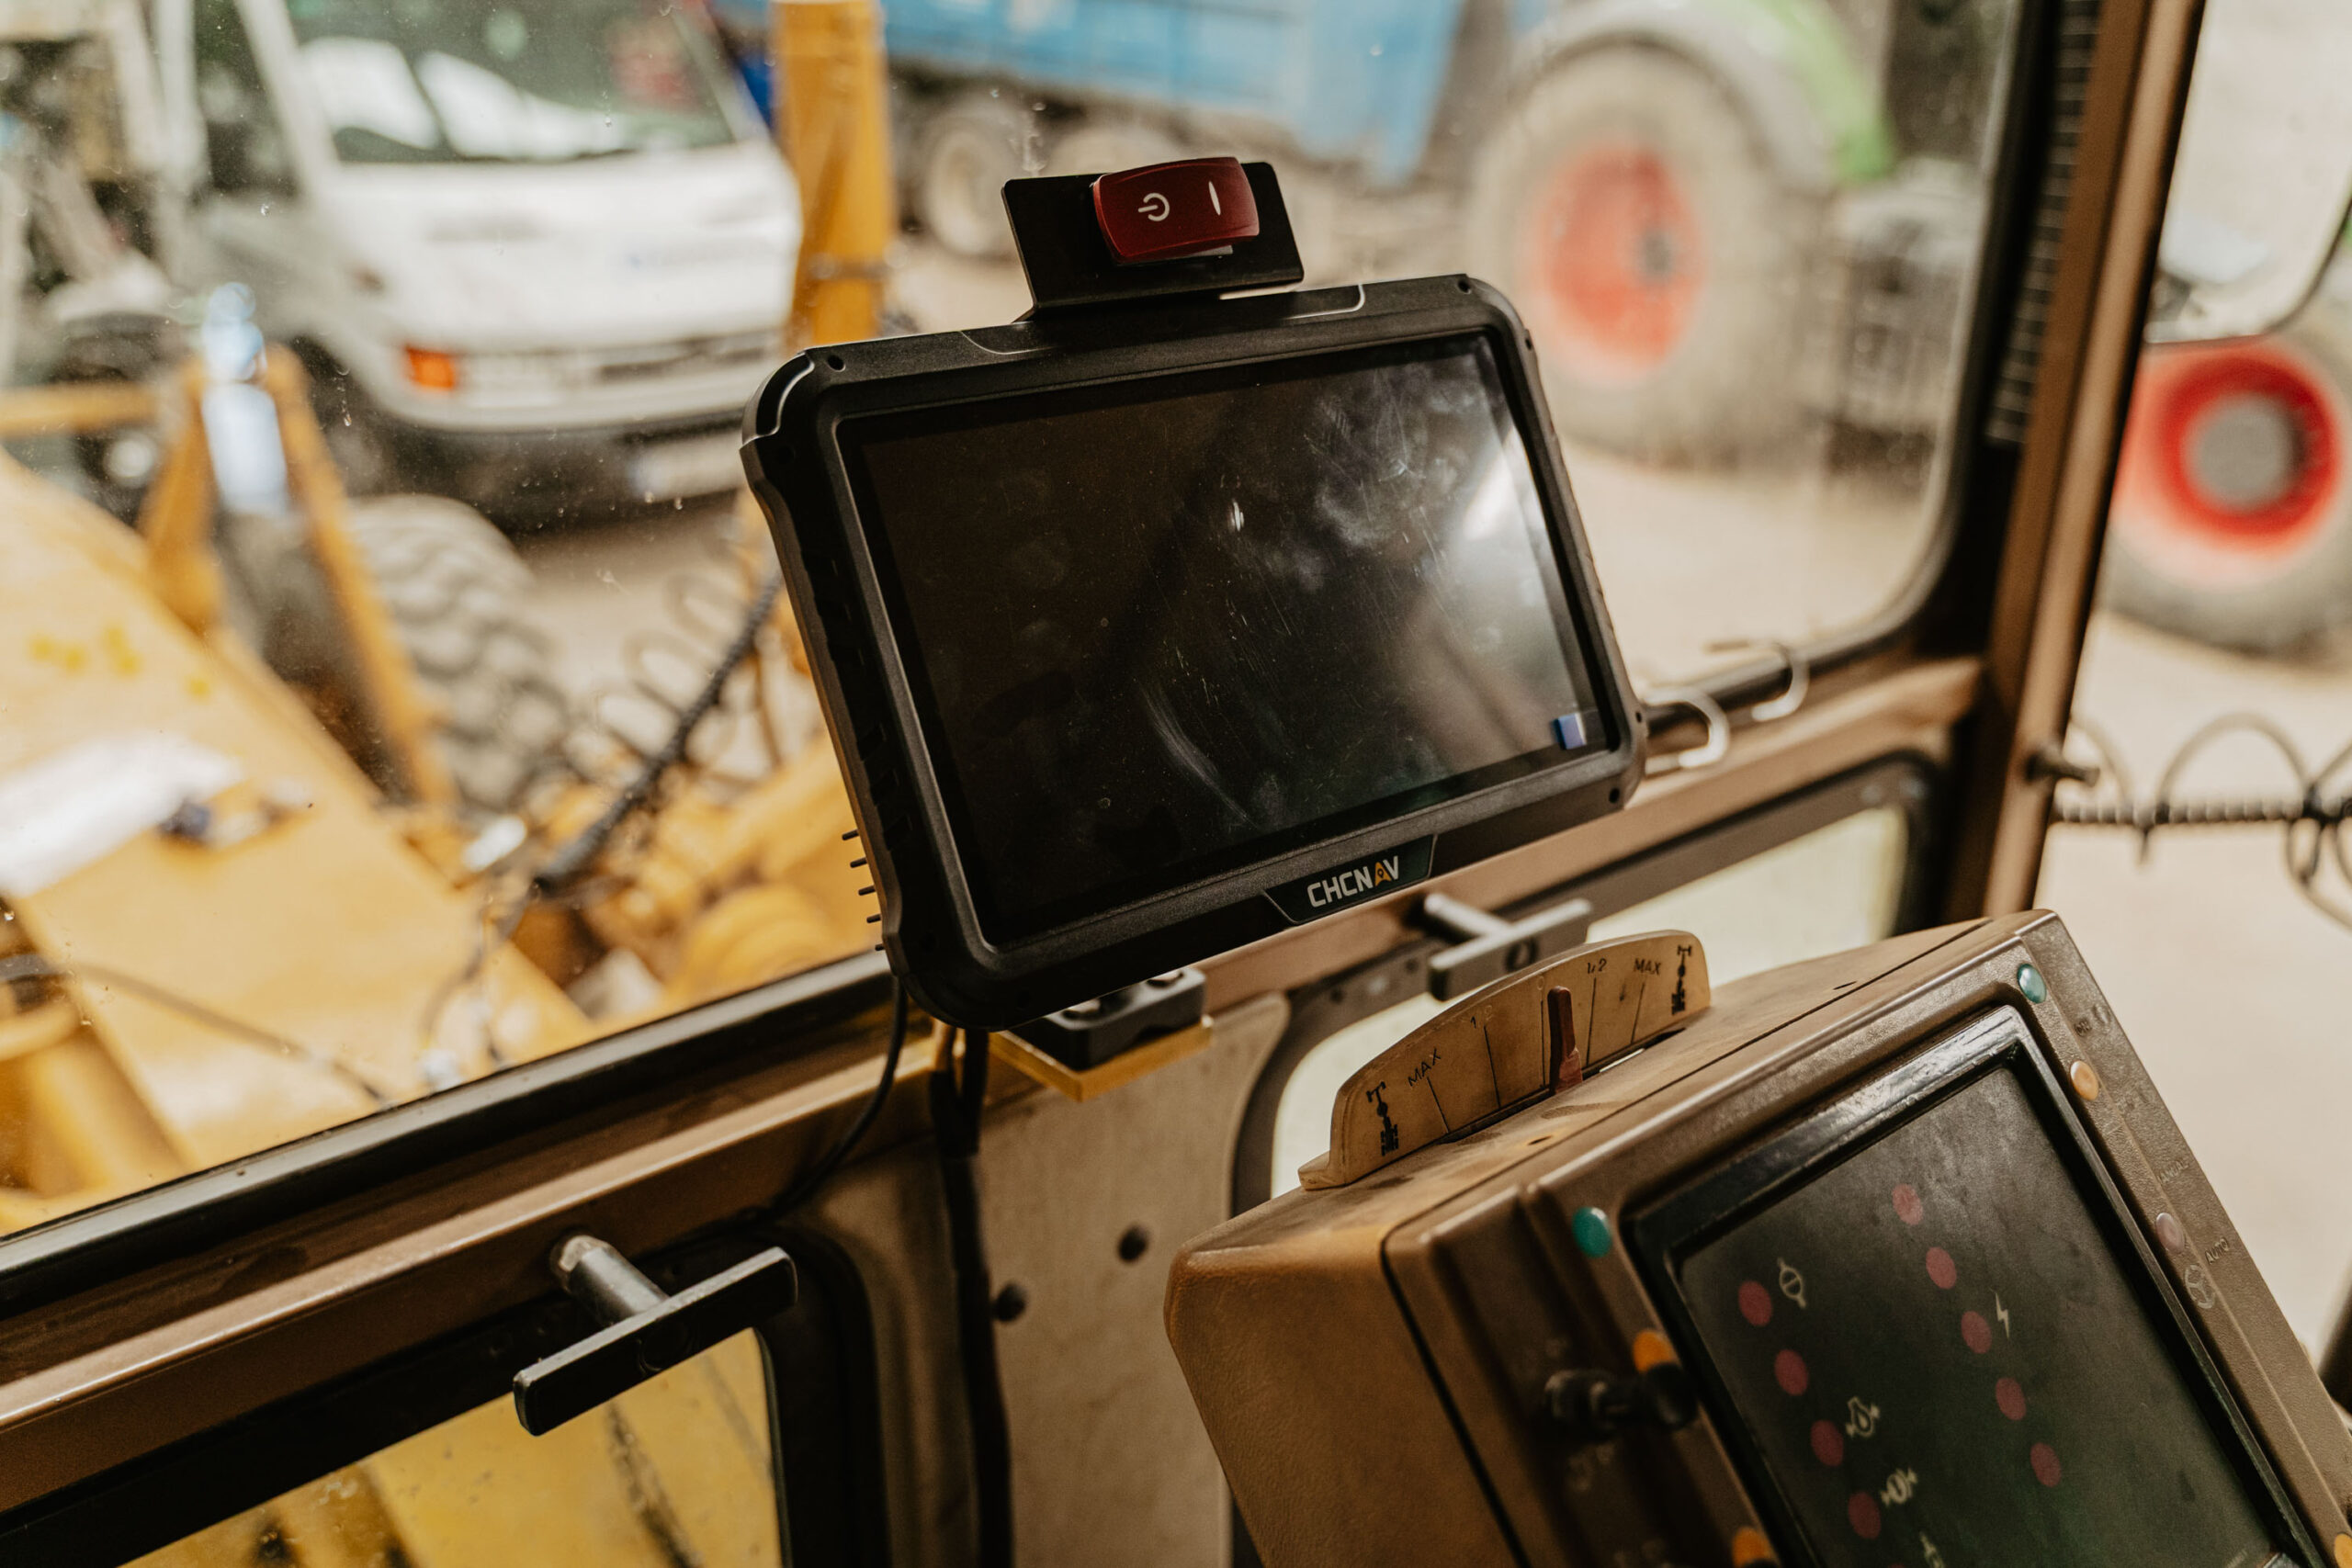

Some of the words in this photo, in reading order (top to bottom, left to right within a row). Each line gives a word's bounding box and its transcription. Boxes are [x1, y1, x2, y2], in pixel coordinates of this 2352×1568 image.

[1306, 855, 1399, 908] CHCNAV
[1634, 958, 1662, 976] MAX
[1408, 1047, 1442, 1088] MAX
[2205, 1236, 2230, 1265] AUTO
